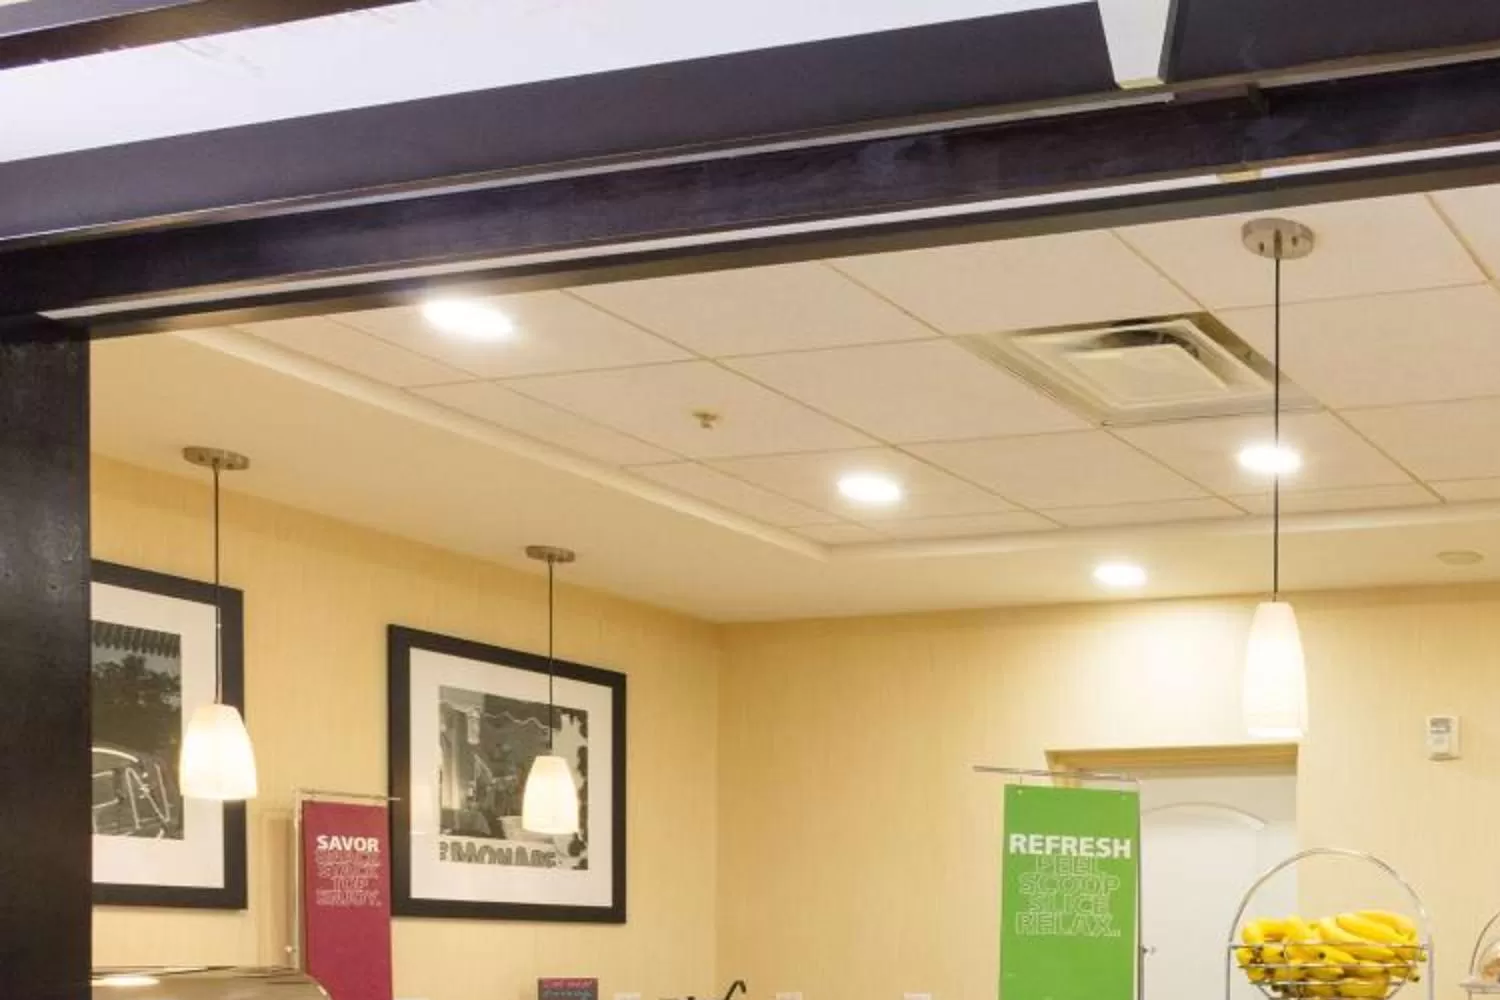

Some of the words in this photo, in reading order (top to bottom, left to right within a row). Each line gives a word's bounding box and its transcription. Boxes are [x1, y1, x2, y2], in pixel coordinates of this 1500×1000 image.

[316, 835, 380, 852] SAVOR
[1009, 833, 1132, 859] REFRESH
[1036, 856, 1104, 877] PEEL
[1018, 872, 1121, 896] SCOOP
[1023, 891, 1111, 914] SLICE
